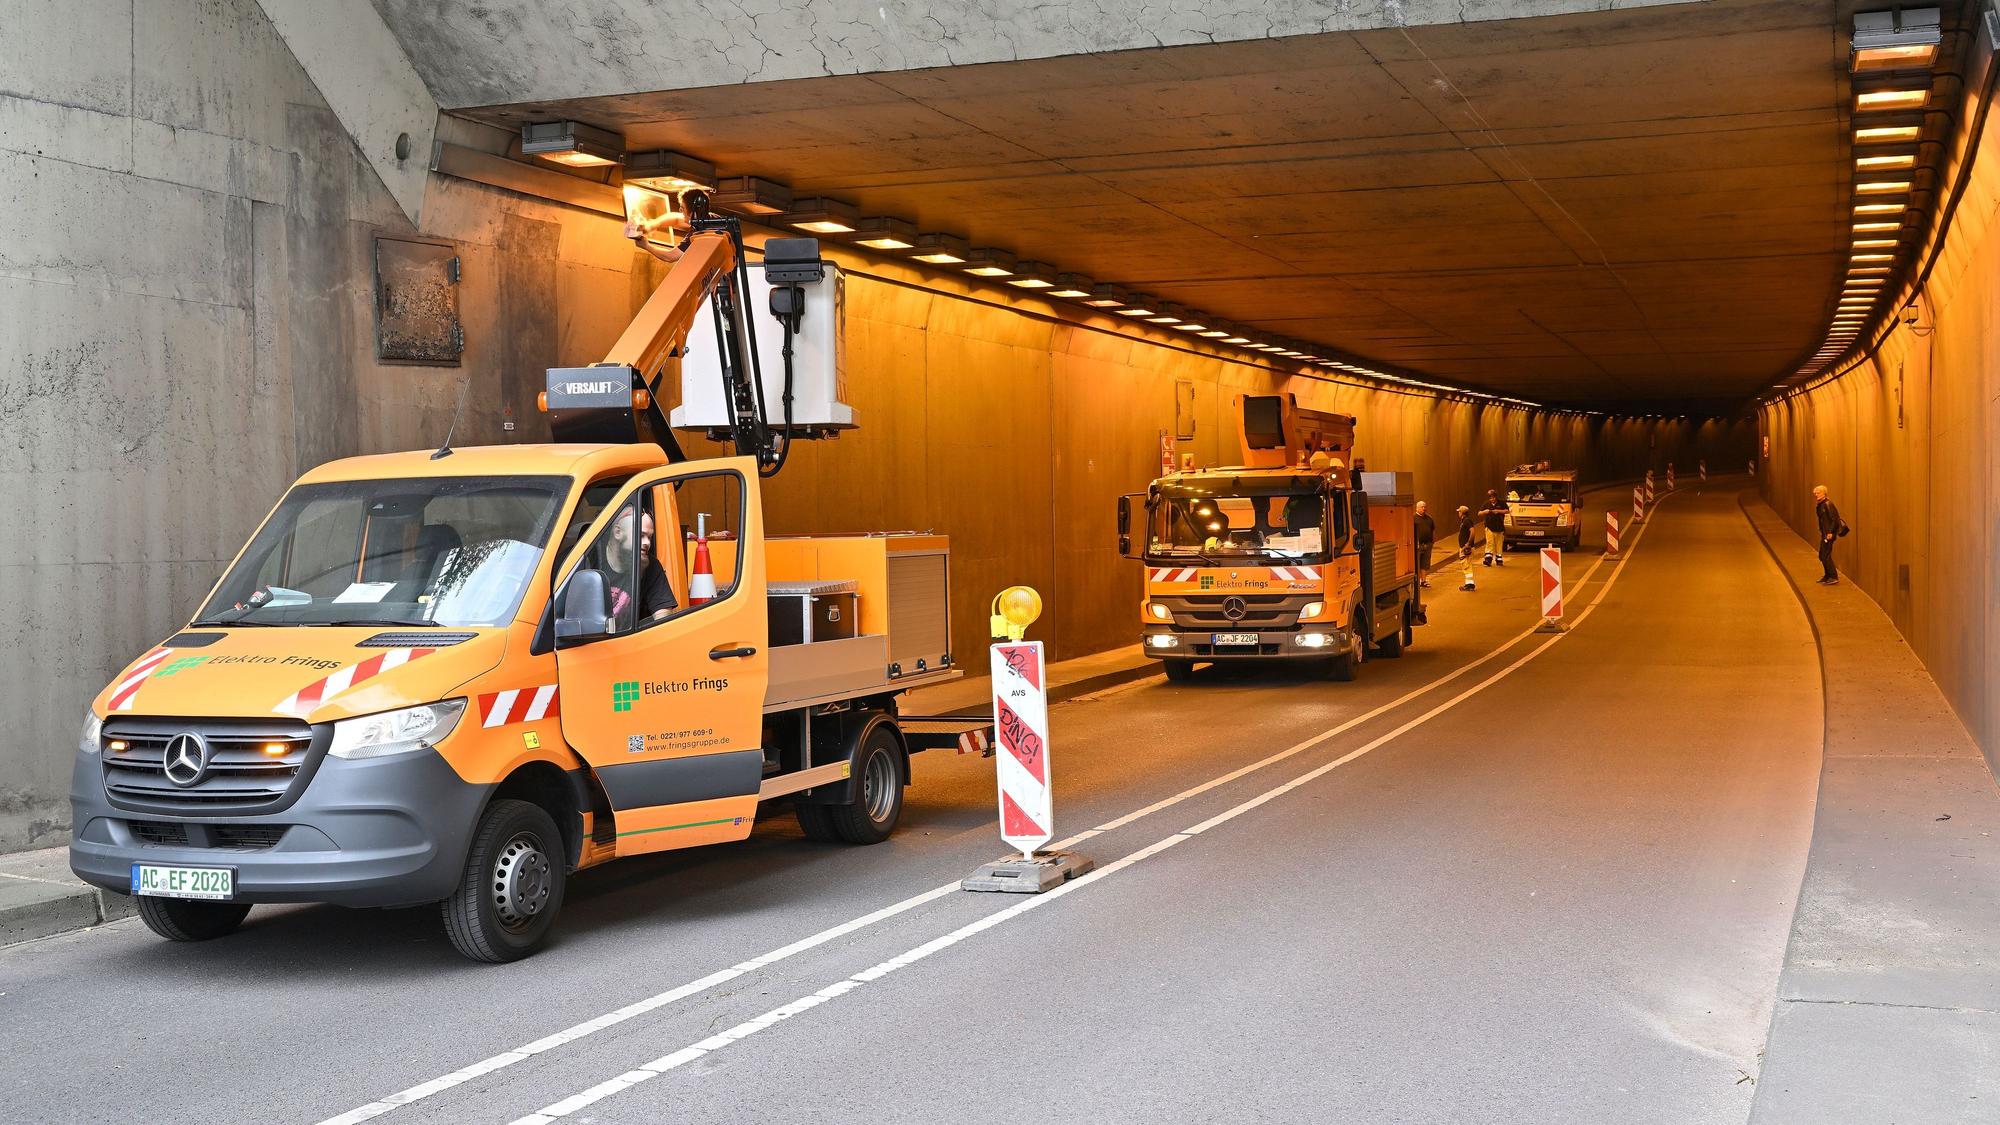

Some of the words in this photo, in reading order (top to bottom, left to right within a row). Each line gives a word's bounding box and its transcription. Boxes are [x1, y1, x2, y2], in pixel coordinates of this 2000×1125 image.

[566, 381, 612, 395] VERSALIFT
[1216, 580, 1243, 588] Elektro
[1244, 580, 1269, 589] Frings
[208, 654, 277, 665] Elektro
[280, 655, 342, 670] Frings
[644, 681, 689, 695] Elektro
[692, 677, 729, 692] Frings
[1011, 689, 1026, 697] AVS
[646, 736, 730, 752] www.fringsgruppe.de
[141, 868, 159, 889] AC
[169, 870, 188, 891] EF
[191, 871, 230, 892] 2028
